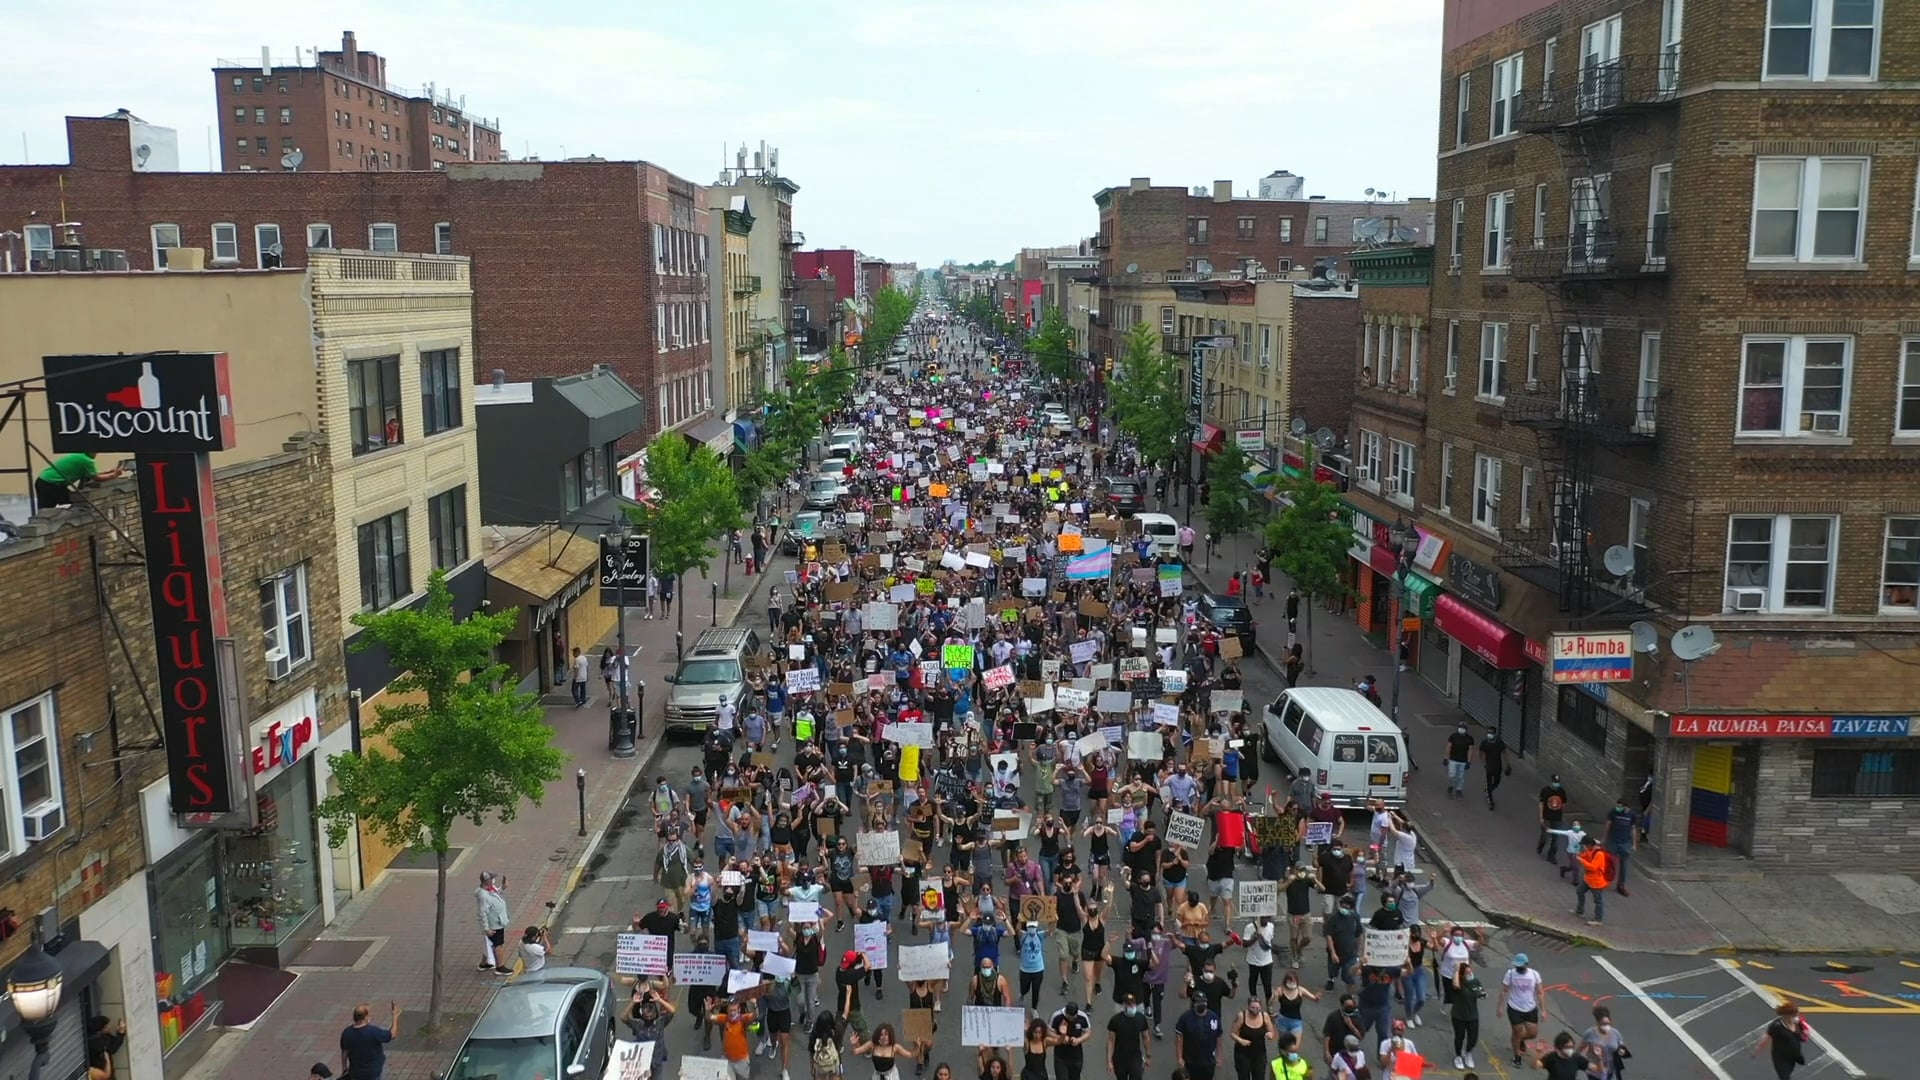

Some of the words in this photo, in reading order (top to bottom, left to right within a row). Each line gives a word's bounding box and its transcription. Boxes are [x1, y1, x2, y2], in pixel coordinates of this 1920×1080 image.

[55, 393, 214, 442] Discount
[1561, 638, 1573, 655] La
[1577, 637, 1624, 656] Rumba
[1561, 670, 1621, 679] TAVERN
[1676, 719, 1698, 733] LA
[1706, 719, 1767, 733] RUMBA
[1775, 719, 1825, 733] PAISA
[1171, 815, 1184, 825] LAS
[1184, 818, 1203, 829] VIDAS
[1257, 816, 1296, 829] BLACK
[1169, 823, 1201, 838] NEGRAS
[1168, 831, 1200, 845] IMPORTAN
